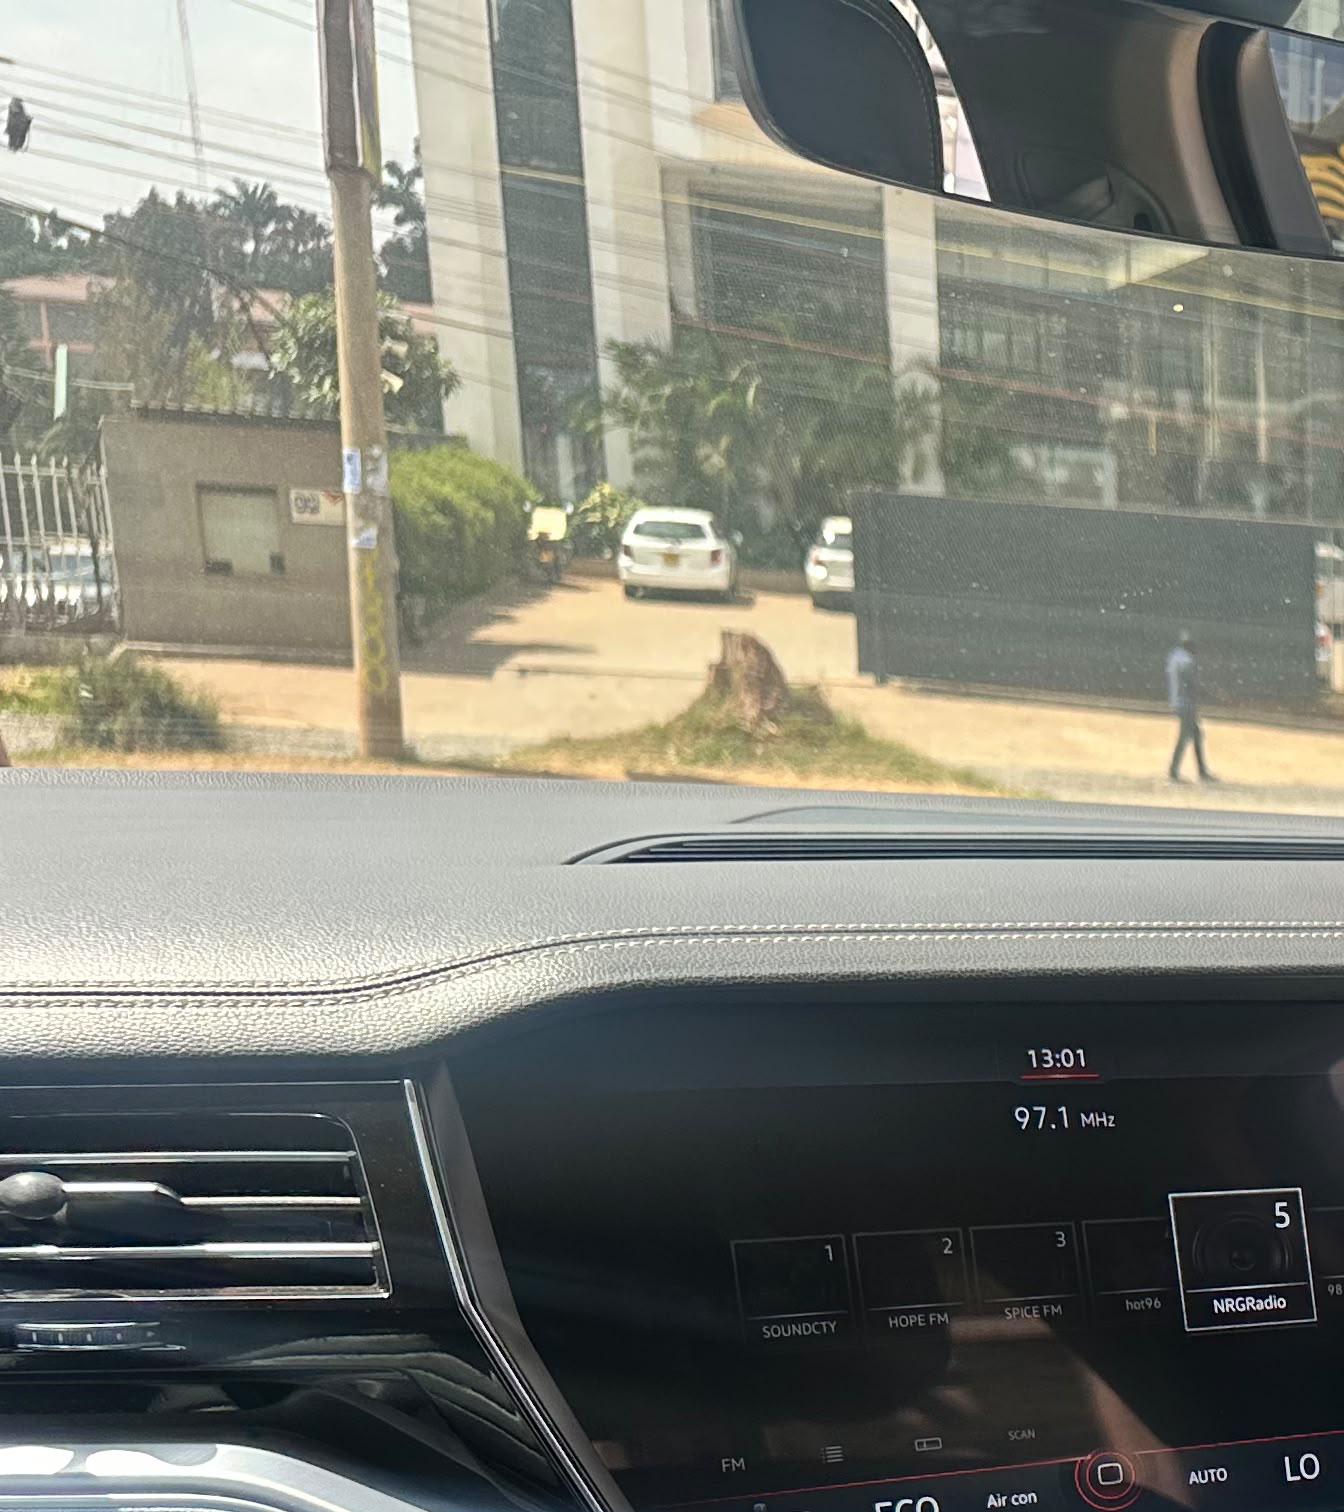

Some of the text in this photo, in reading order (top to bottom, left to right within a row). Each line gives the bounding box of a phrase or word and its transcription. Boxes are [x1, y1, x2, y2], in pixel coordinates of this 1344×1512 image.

[1028, 1048, 1086, 1068] 13:01
[1014, 1106, 1116, 1130] 97.1 MHz
[1274, 1201, 1291, 1229] 5
[942, 1237, 953, 1254] 2
[1055, 1231, 1066, 1248] 3
[824, 1244, 834, 1262] 1
[1004, 1304, 1062, 1321] SPICE FM
[1125, 1296, 1162, 1312] hot96
[1213, 1294, 1287, 1314] NRGRadio
[762, 1320, 838, 1340] SOUNDCTY
[888, 1312, 949, 1330] HOPE FM
[1008, 1428, 1036, 1441] SCAN
[721, 1458, 746, 1473] FM
[986, 1493, 1007, 1509] Air
[1011, 1492, 1038, 1507] con
[1188, 1468, 1228, 1485] AUTO
[1284, 1453, 1320, 1482] LO
